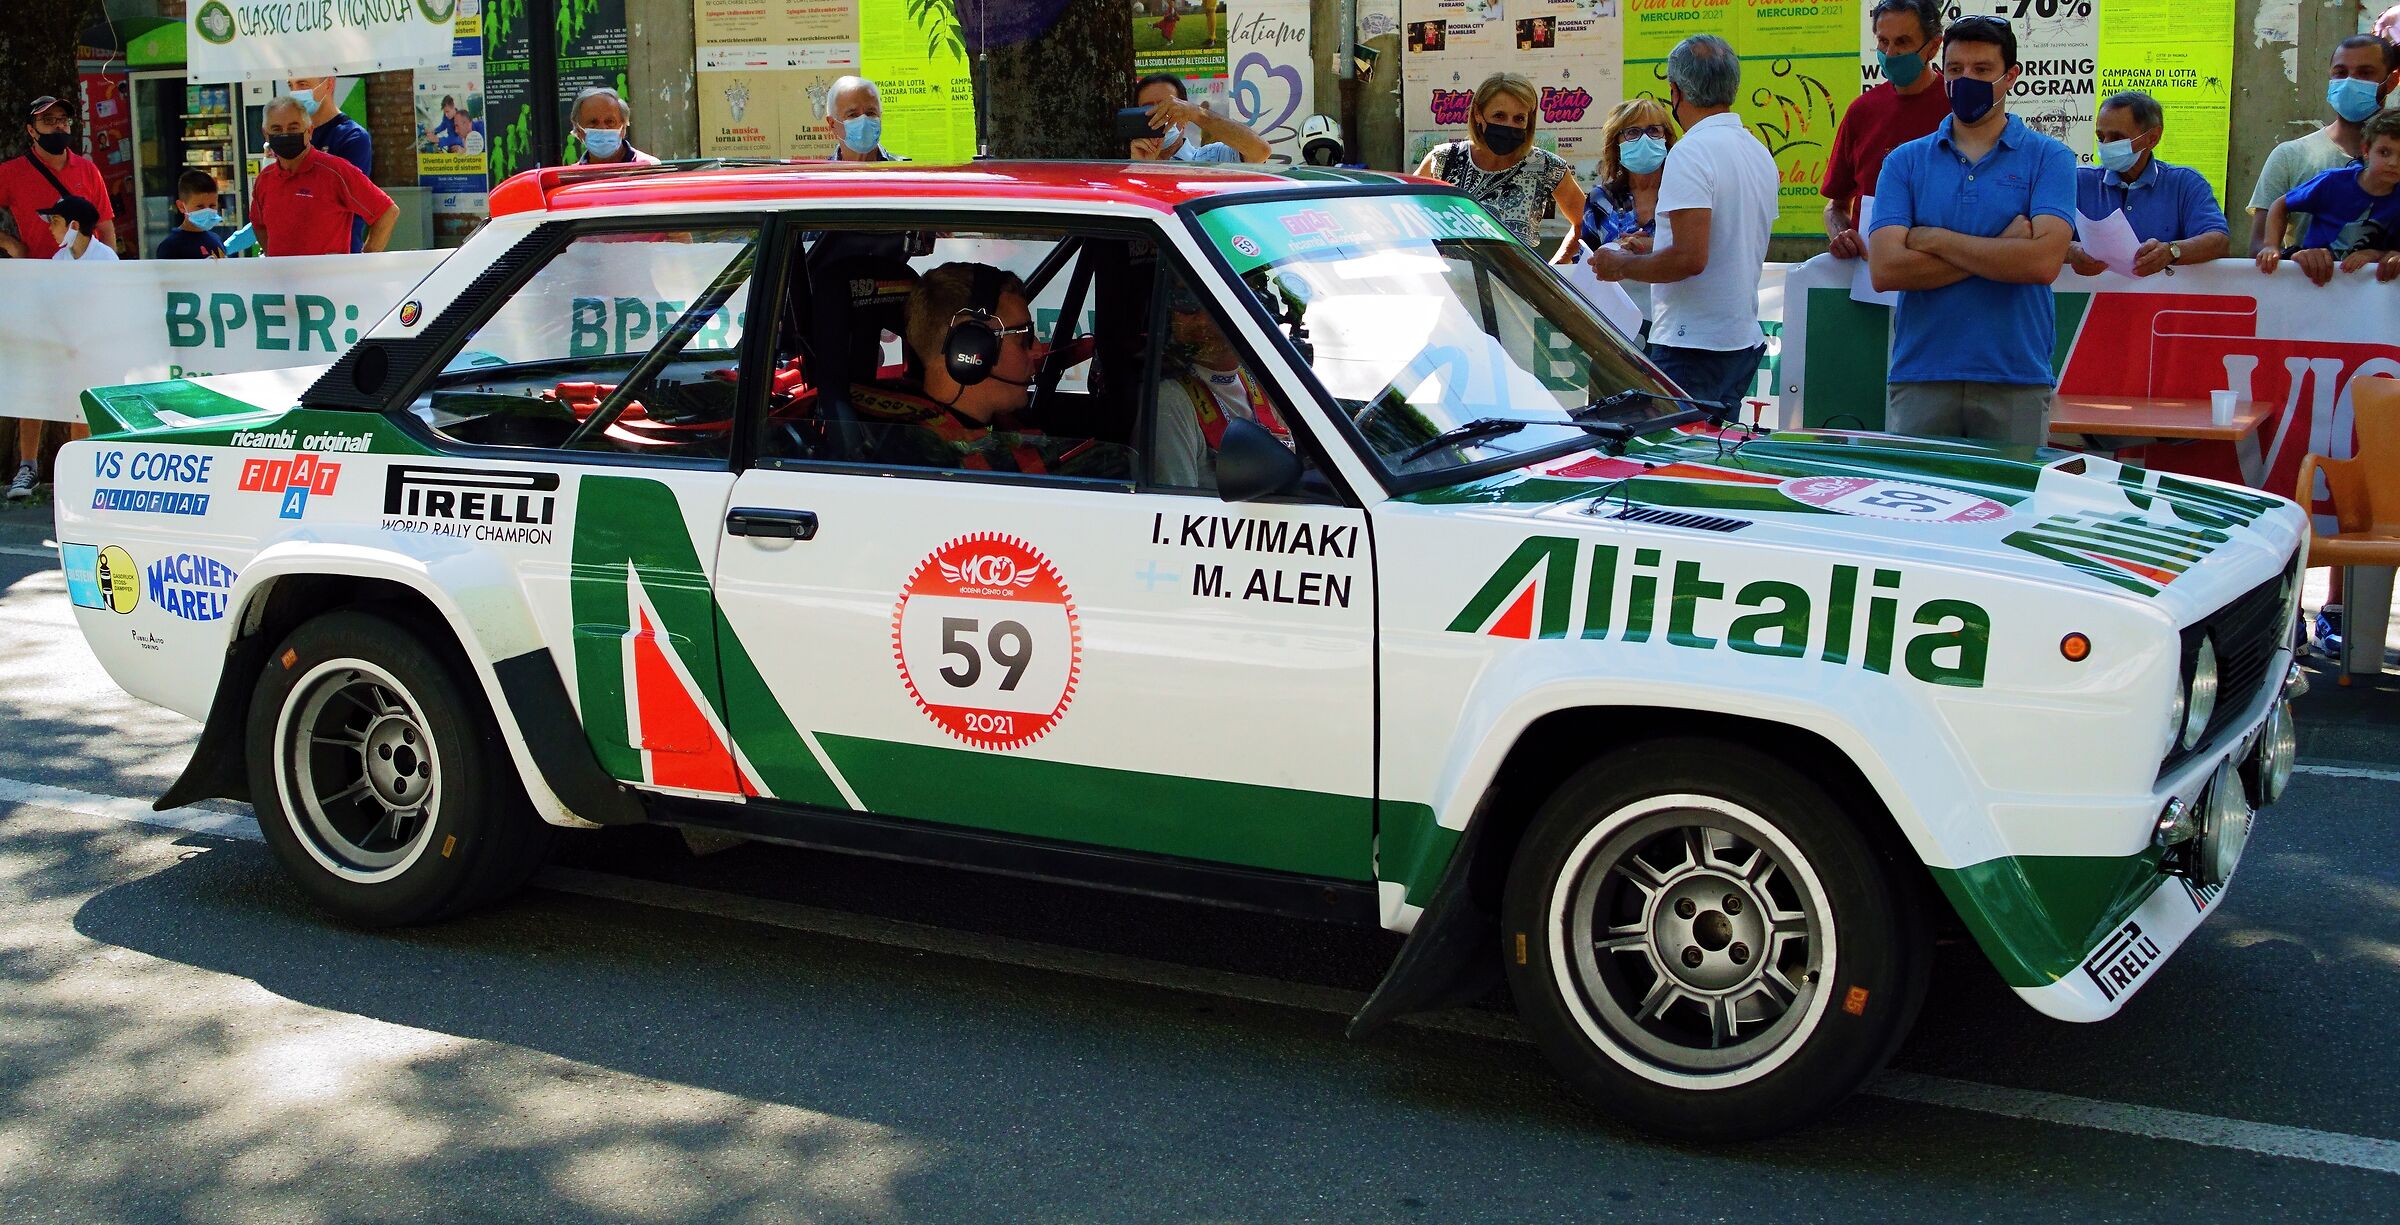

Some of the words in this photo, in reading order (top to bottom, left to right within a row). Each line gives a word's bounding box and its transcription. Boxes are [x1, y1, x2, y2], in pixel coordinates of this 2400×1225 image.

[237, 4, 292, 37] CLASSIC
[296, 0, 333, 32] CLUB
[337, 0, 413, 30] VIGNOLA
[1641, 11, 1700, 22] MERCURDO
[1702, 10, 1723, 20] 2021
[1757, 7, 1818, 18] MERCURDO
[1821, 6, 1843, 16] 2021
[2102, 69, 2151, 77] CAMPAGNA
[2156, 69, 2164, 77] DI
[2169, 69, 2197, 77] LOTTA
[2102, 79, 2125, 87] ALLA
[2127, 79, 2168, 87] ZANZARA
[2171, 79, 2198, 87] TIGRE
[1433, 90, 1474, 110] Estat
[1541, 88, 1591, 110] Estate
[1545, 105, 1582, 122] bene
[2026, 115, 2092, 123] PROMOZIONALE
[1790, 160, 1805, 183] la
[1777, 186, 1818, 196] CURDO
[1390, 203, 1506, 241] Alitalia
[1238, 238, 1254, 254] 59
[957, 353, 982, 366] Stilo
[230, 426, 298, 450] ricambi
[302, 432, 374, 453] originali
[95, 450, 124, 479] VS
[130, 452, 214, 484] CORSE
[93, 489, 209, 515] OLIOFIAT
[384, 464, 560, 525] PIRELLI
[1858, 490, 1952, 513] 59
[380, 519, 428, 535] WORLD
[432, 522, 472, 539] RALLY
[475, 526, 552, 545] CHAMPION
[1152, 512, 1170, 545] I.
[1180, 514, 1358, 559] KIVIMAKI
[2001, 464, 2285, 598] Alitalia
[1192, 564, 1232, 599] M.
[1242, 568, 1352, 608] ALEN
[1445, 535, 1991, 688] Alitalia
[939, 616, 1033, 692] 59
[965, 713, 1014, 735] 2021
[2082, 920, 2162, 1003] PIRELLI
